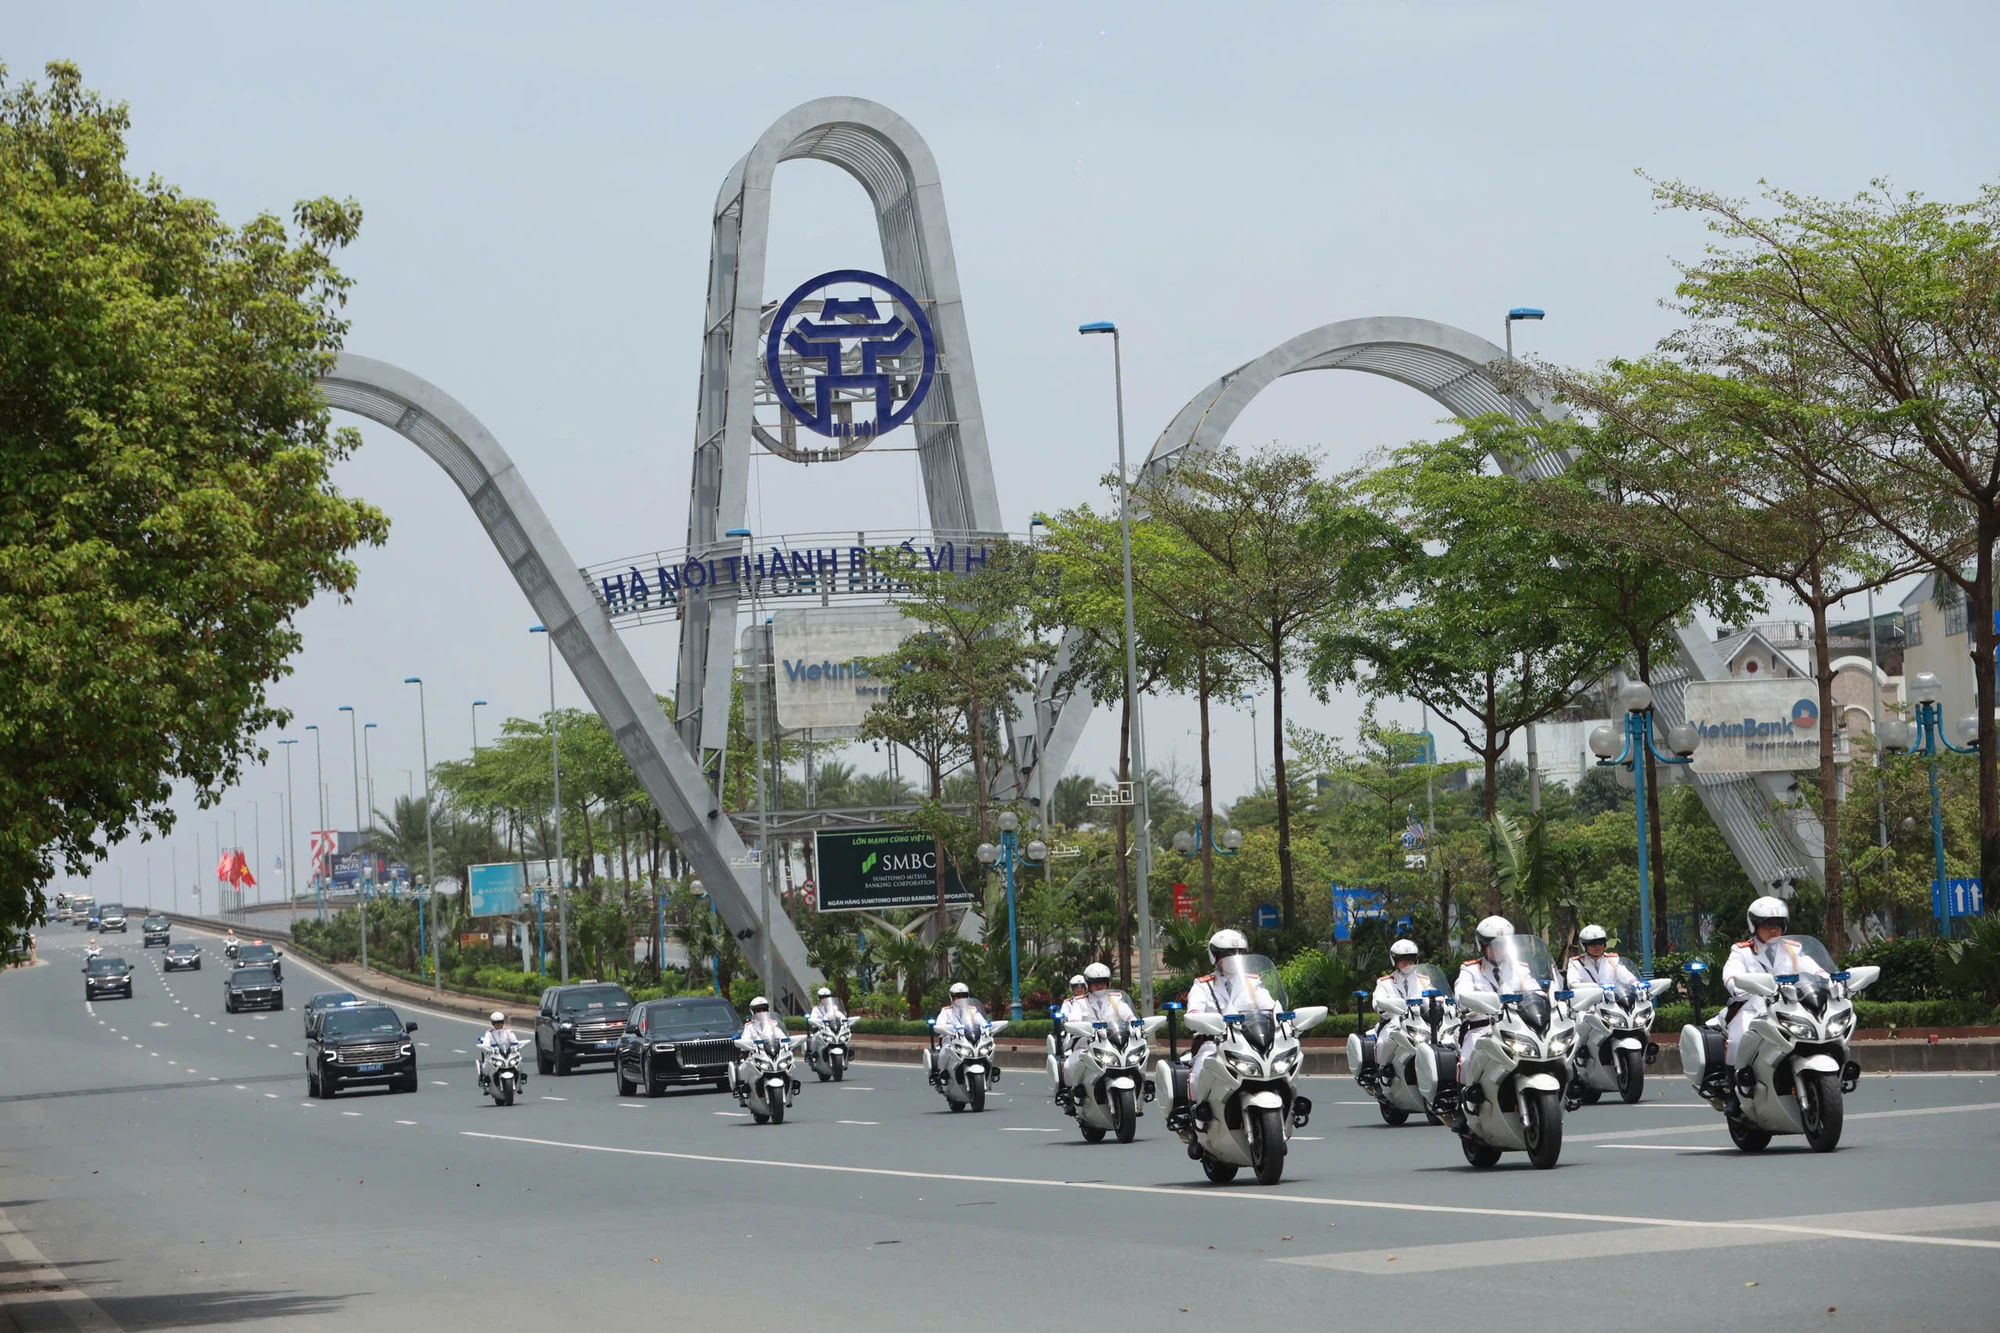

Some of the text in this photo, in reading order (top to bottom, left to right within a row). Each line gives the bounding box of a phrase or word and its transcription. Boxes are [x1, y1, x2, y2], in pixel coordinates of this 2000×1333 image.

[602, 566, 651, 607] HÀ
[658, 556, 717, 594] NỘI
[722, 546, 838, 583] THÀNH
[925, 541, 954, 573] VÌ
[1690, 717, 1794, 739] VietinBank
[867, 837, 889, 846] MẠNH
[889, 835, 909, 843] CÙNG
[882, 852, 936, 871] SMBC
[872, 874, 906, 882] SUMITOMO
[865, 879, 936, 889] BANKING CORPORATION
[861, 897, 891, 905] SUMITOMO
[911, 894, 936, 902] BANKING
